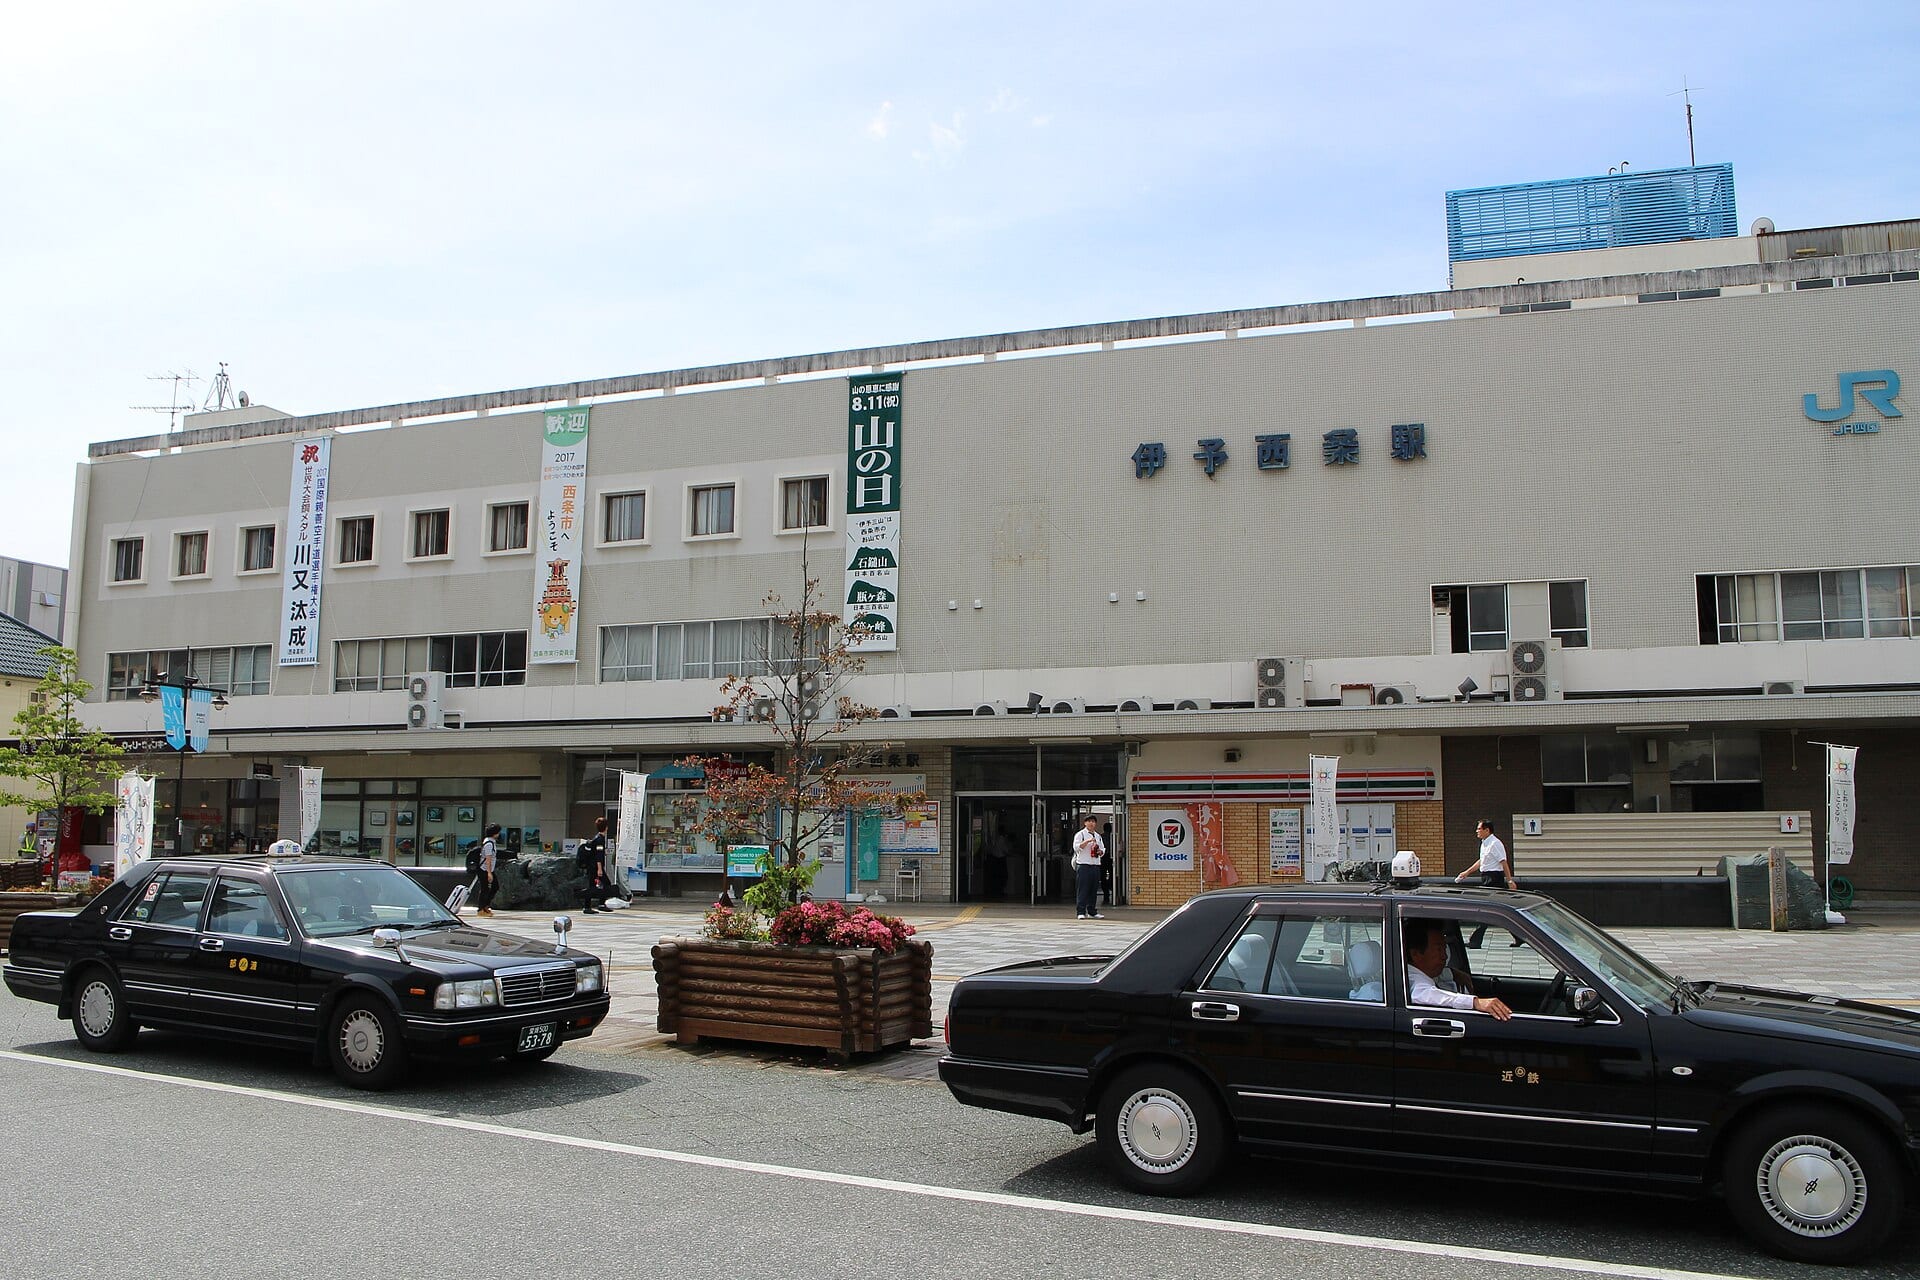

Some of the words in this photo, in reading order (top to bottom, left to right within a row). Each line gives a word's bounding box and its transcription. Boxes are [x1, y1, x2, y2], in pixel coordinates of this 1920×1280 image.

[1803, 369, 1903, 422] JR
[546, 412, 587, 435] 歓迎
[300, 444, 320, 464] 祝
[554, 452, 576, 463] 2017
[854, 416, 896, 509] 山の日
[1131, 423, 1428, 480] 伊予西条駅
[546, 510, 558, 552] ようこそ
[560, 485, 578, 541] 西条市へ
[1155, 852, 1188, 861] Kiosk
